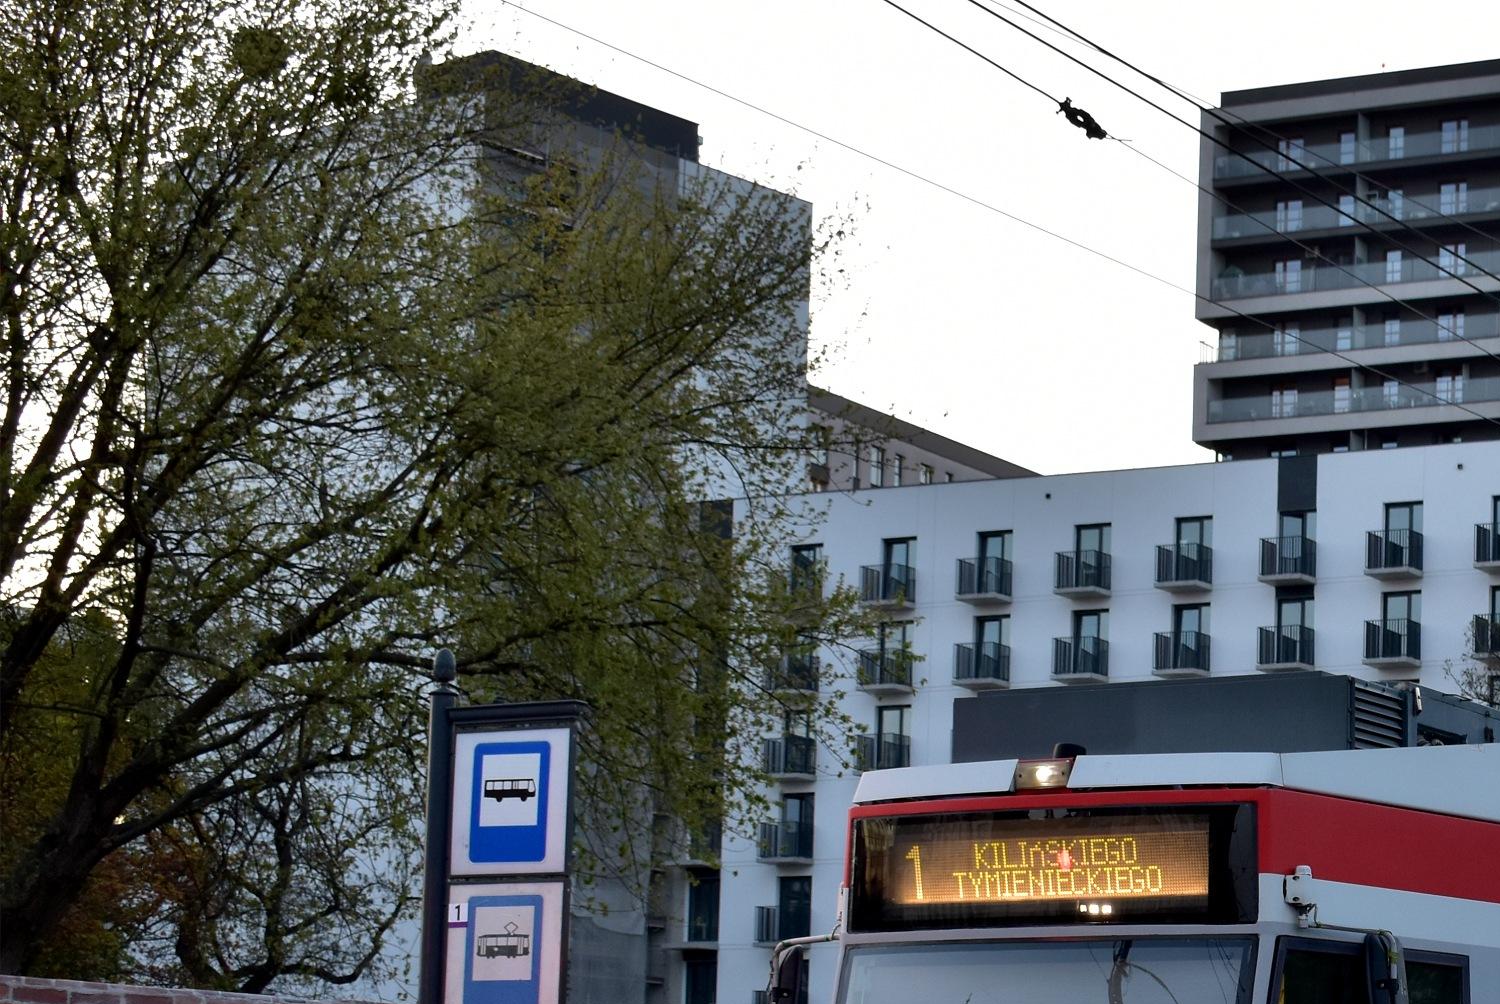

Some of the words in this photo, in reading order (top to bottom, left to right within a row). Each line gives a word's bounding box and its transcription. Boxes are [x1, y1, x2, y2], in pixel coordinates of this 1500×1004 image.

[905, 844, 925, 900] 1
[952, 864, 1164, 899] TYMIENIECKIEGO
[455, 905, 461, 921] 1
